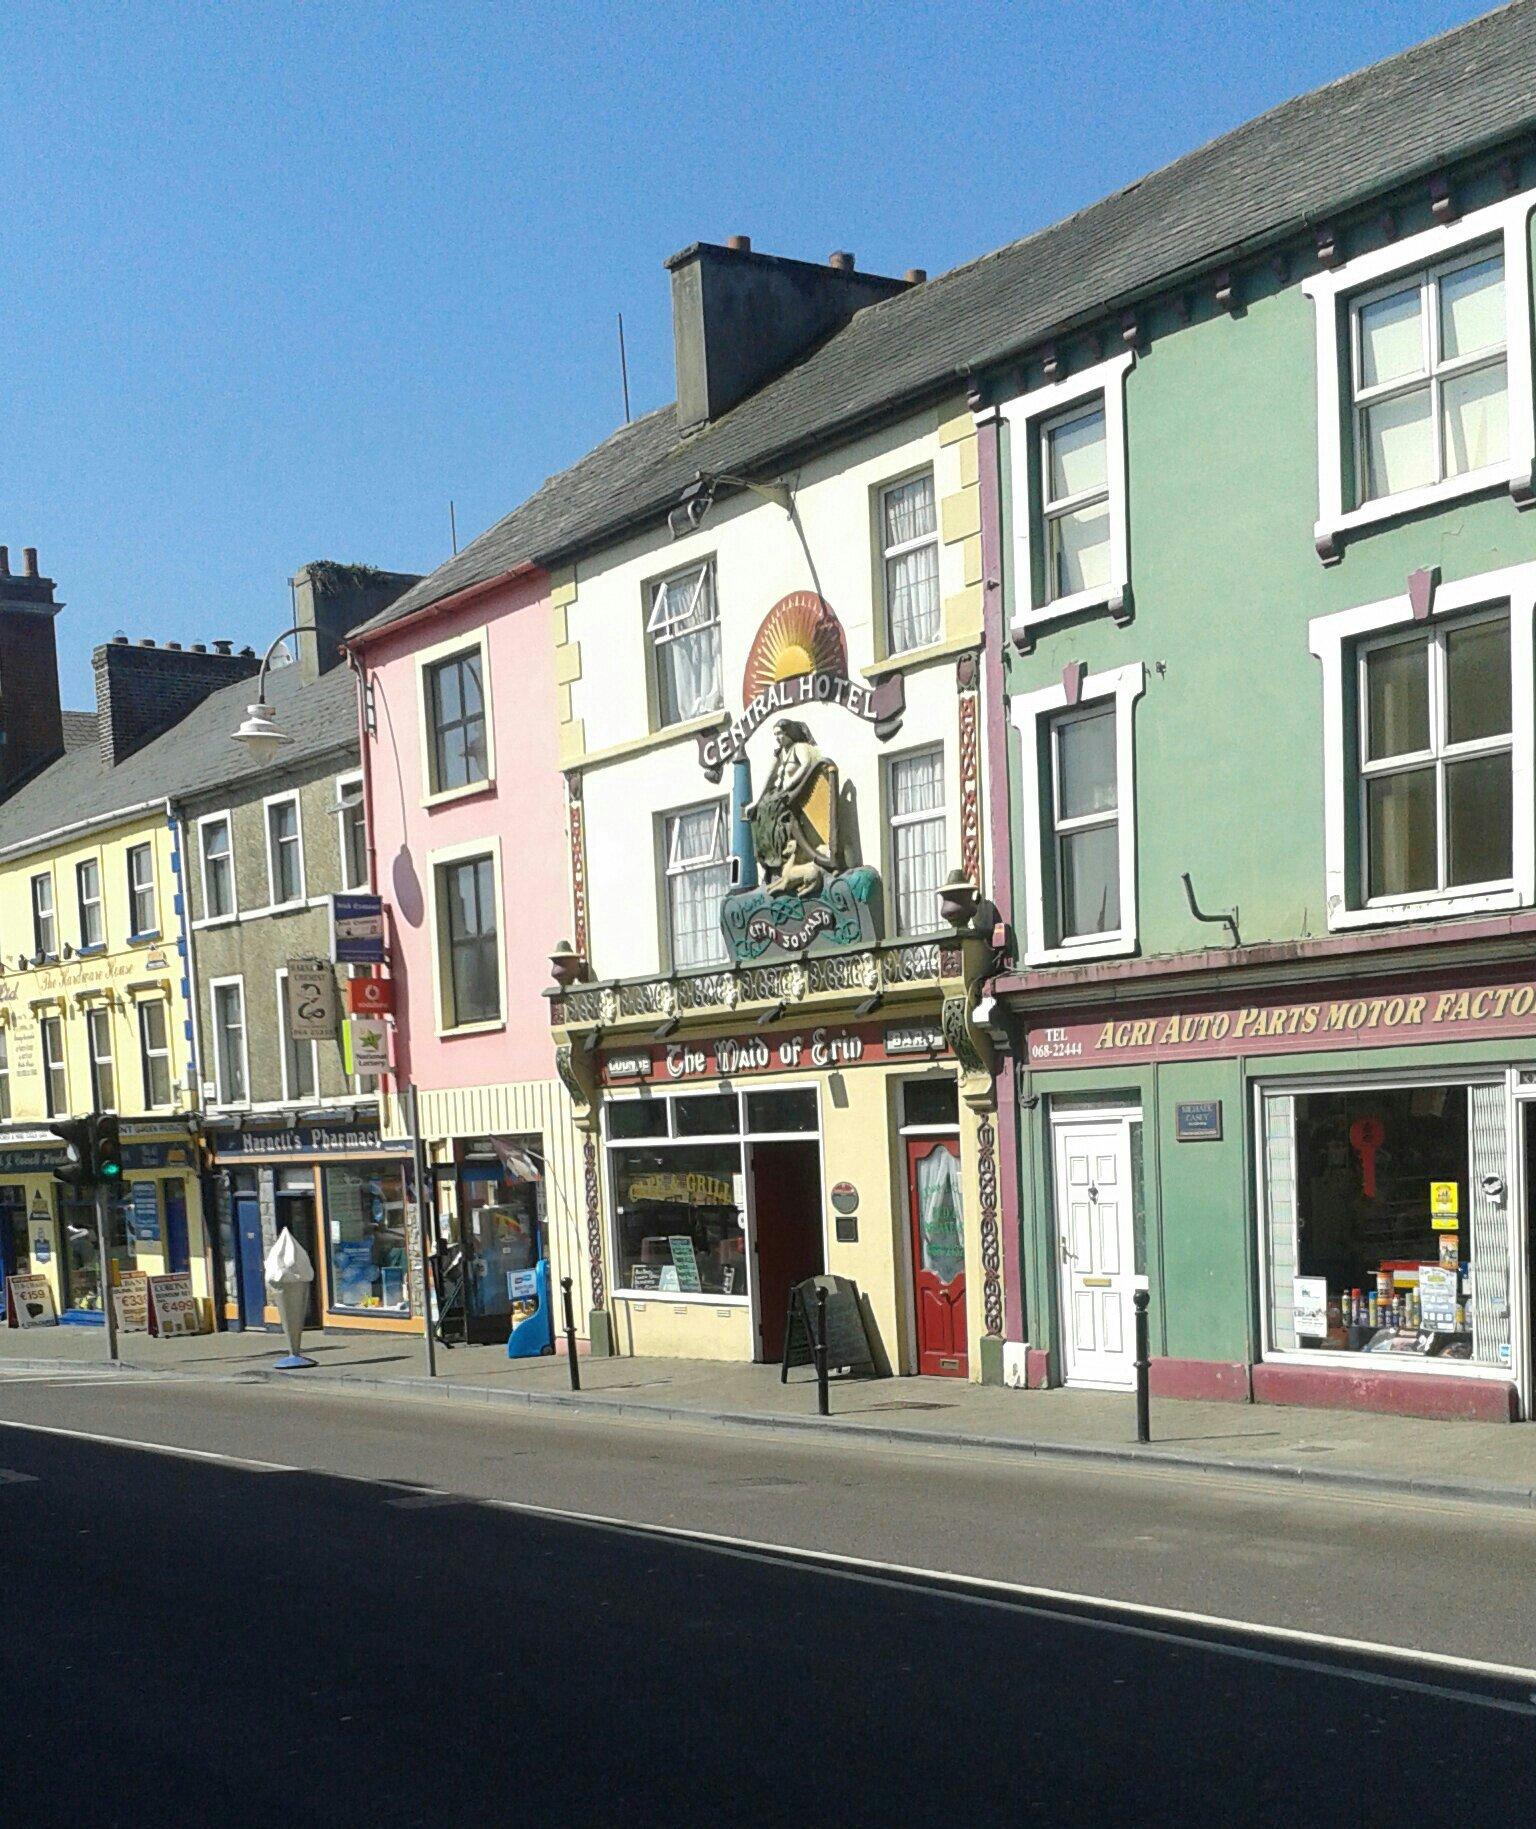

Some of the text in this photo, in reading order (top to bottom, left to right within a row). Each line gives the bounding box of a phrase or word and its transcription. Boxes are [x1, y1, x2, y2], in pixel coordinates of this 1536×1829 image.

[704, 676, 878, 766] CENTRAL HOTEL
[1095, 985, 1536, 1049] AGRI AUTO PARTS MOTOR FACTO
[1045, 1028, 1068, 1042] TEL
[666, 1028, 863, 1078] The Maid of Erin
[1032, 1042, 1082, 1058] 068-22444
[242, 1127, 382, 1153] Harnett's Pharmacy
[20, 1289, 46, 1301] €159
[161, 1300, 194, 1313] €499
